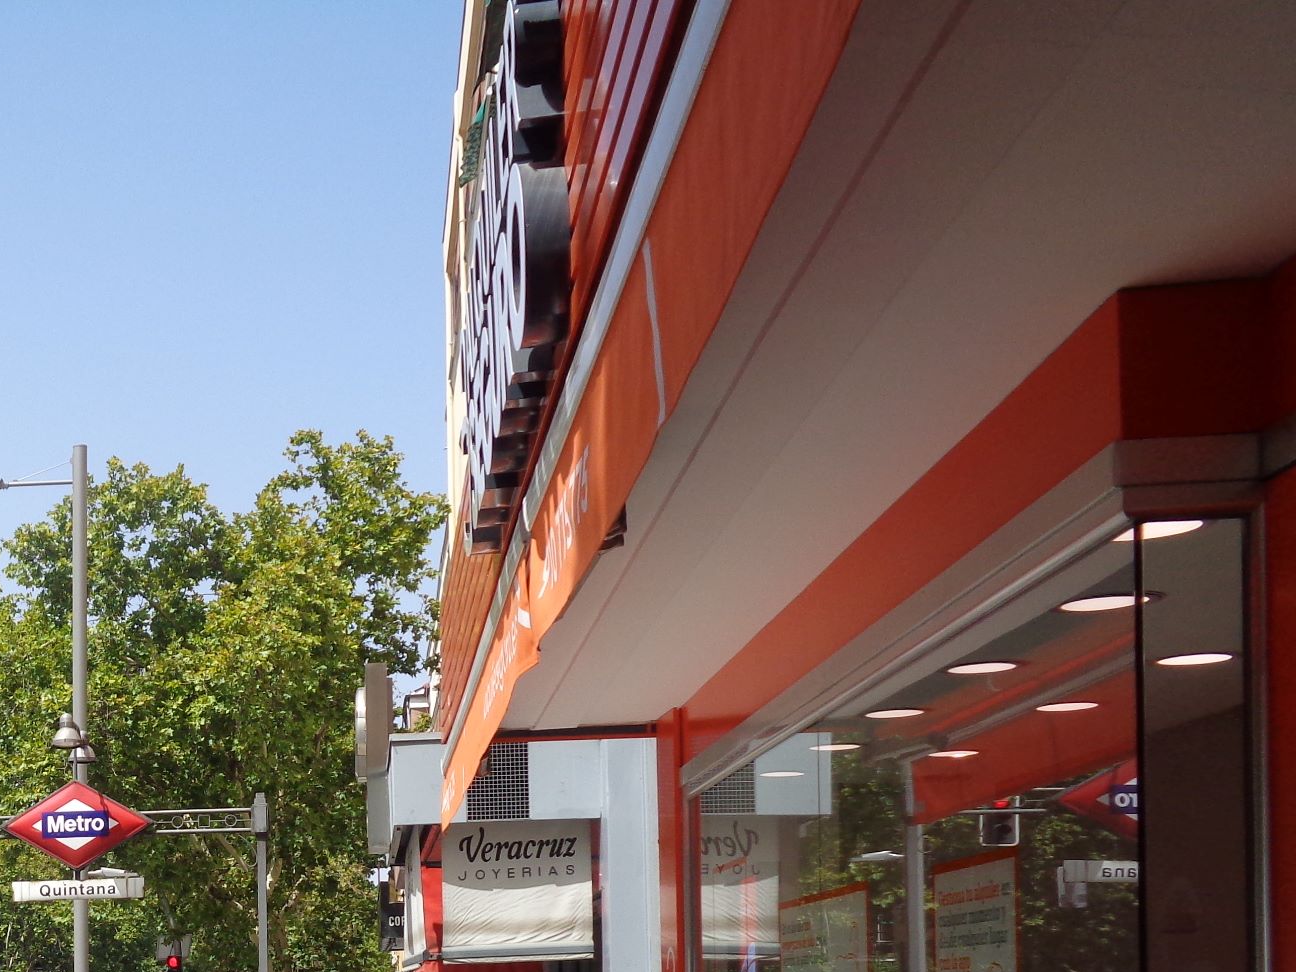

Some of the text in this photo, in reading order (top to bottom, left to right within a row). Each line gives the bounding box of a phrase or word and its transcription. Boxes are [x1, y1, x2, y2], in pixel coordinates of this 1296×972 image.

[46, 814, 105, 834] Metro
[458, 827, 578, 863] Veracruz
[458, 864, 576, 881] JOYERIAS
[39, 883, 116, 898] Quintana
